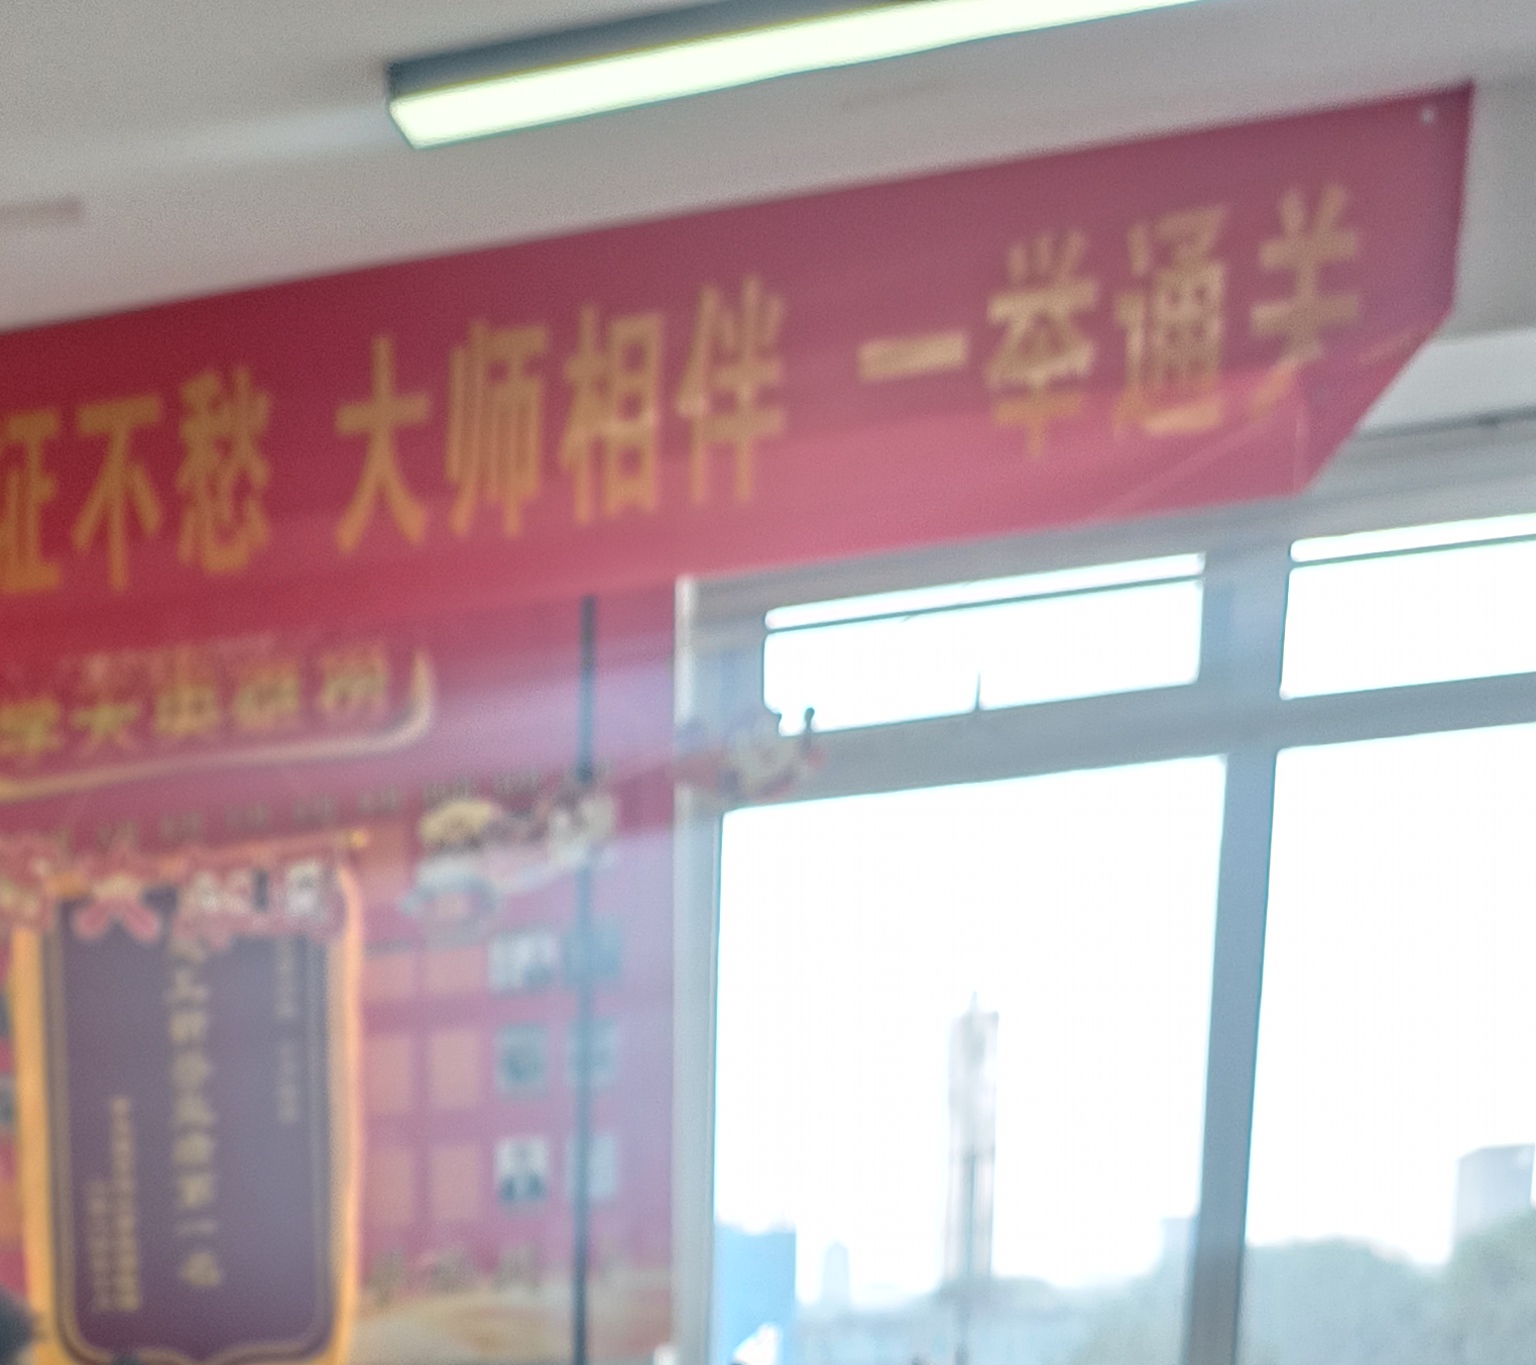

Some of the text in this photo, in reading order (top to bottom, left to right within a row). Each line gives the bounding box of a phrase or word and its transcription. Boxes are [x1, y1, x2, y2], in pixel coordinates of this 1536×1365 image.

[335, 273, 788, 556] 大师相伴
[857, 182, 1363, 460] 一举通关
